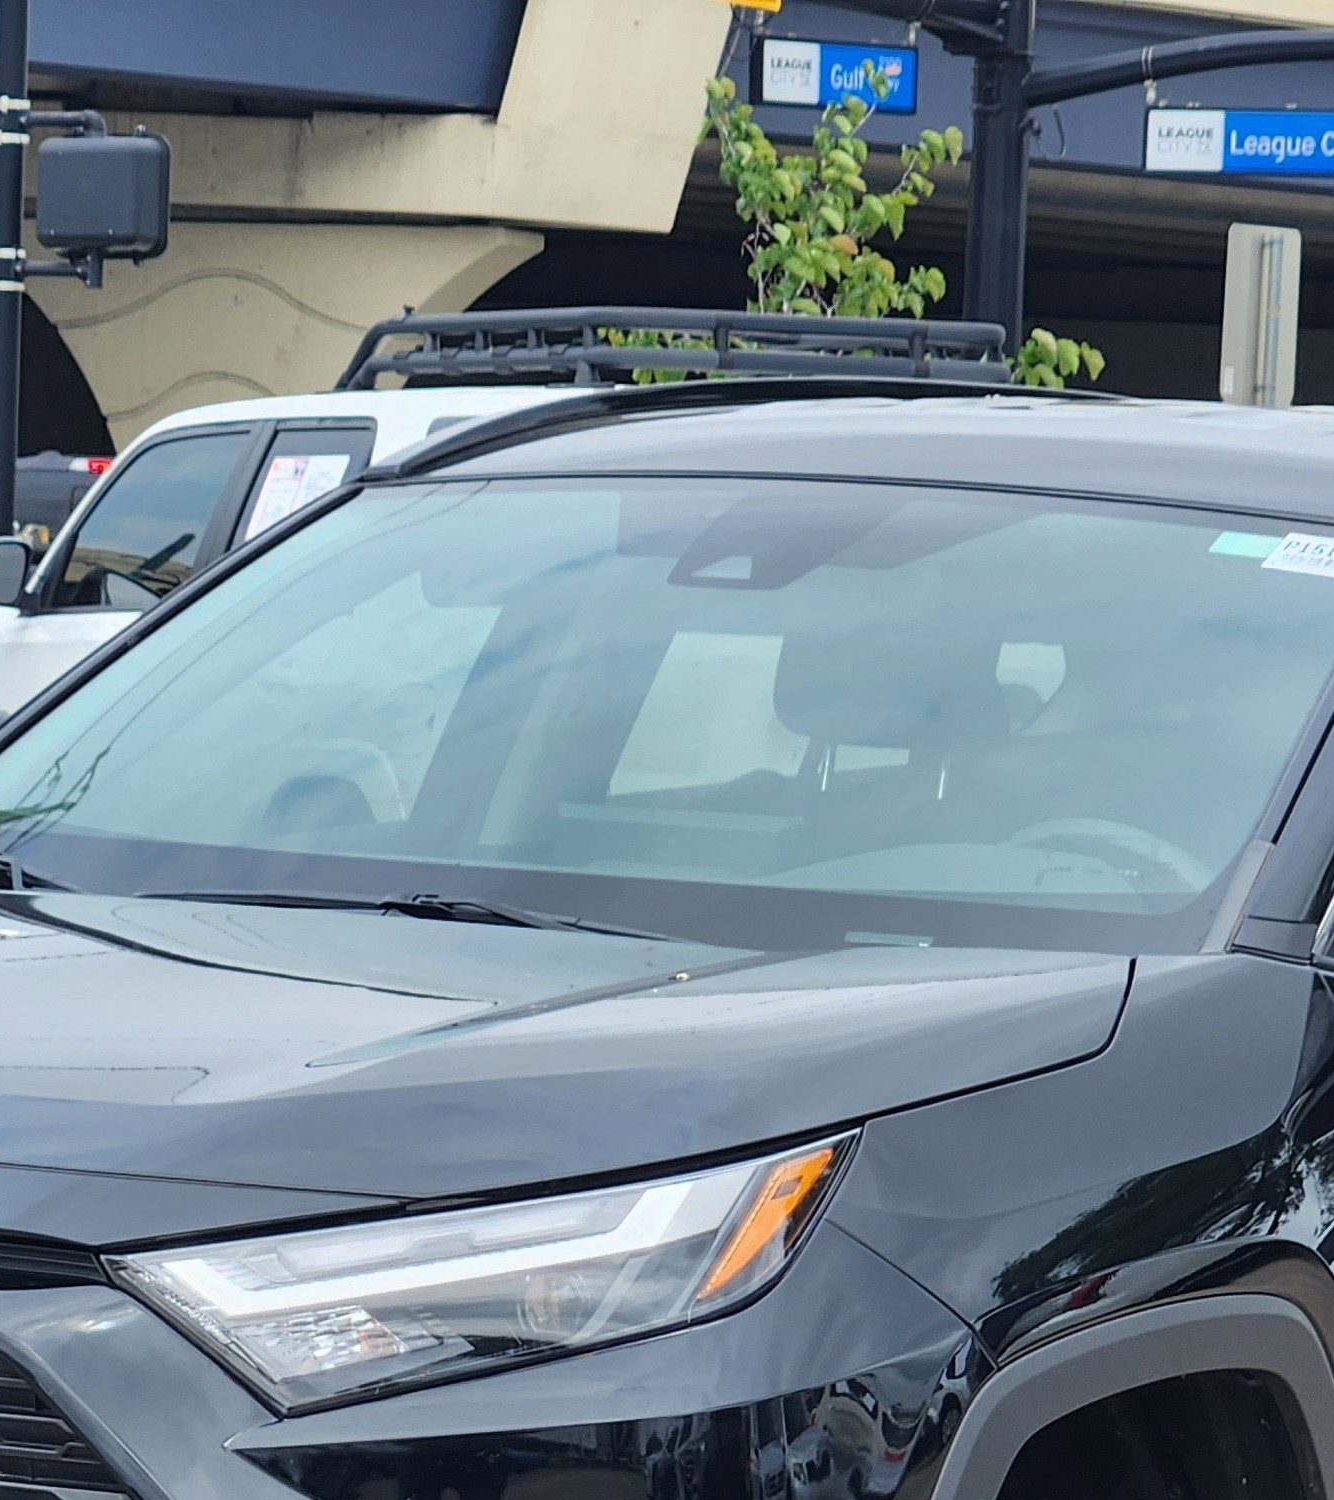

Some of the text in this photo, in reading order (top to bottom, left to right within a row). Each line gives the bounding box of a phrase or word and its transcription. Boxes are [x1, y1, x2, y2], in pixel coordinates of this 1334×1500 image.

[770, 56, 813, 70] LEAGUE
[830, 62, 865, 90] Gulf
[1157, 126, 1214, 139] LEAGUE
[1229, 128, 1317, 164] League
